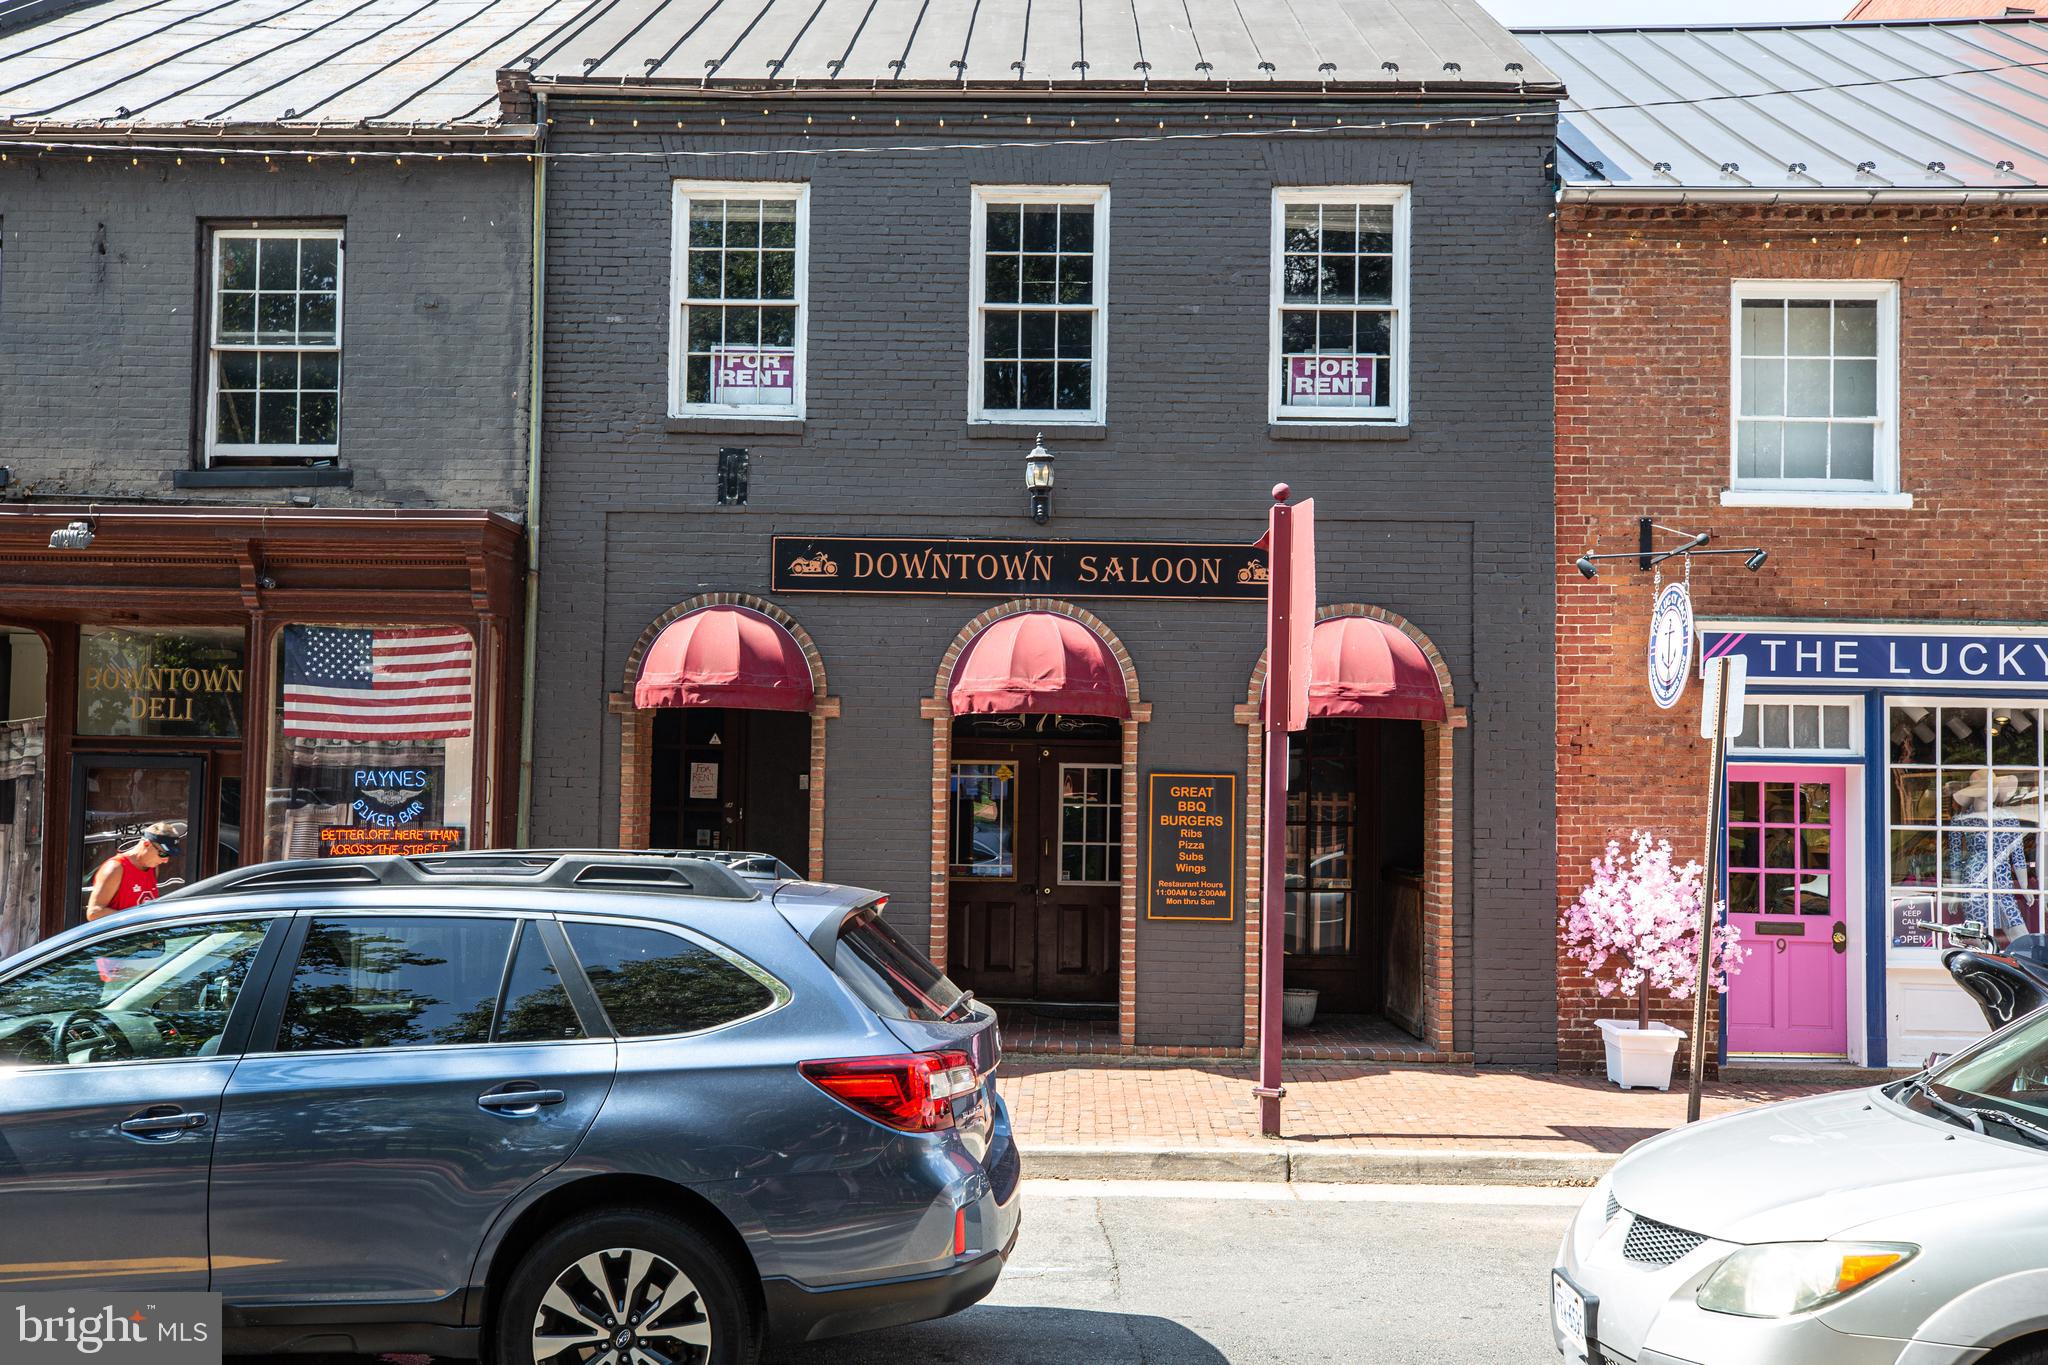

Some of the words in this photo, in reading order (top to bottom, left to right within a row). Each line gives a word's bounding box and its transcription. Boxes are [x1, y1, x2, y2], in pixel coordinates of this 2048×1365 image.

[727, 353, 781, 369] FOR
[1304, 359, 1360, 376] FOR
[718, 369, 790, 386] RENT
[1295, 377, 1369, 393] RENT
[853, 547, 1054, 583] DOWNTOWN
[1078, 555, 1222, 585] SALOON
[1760, 639, 1859, 673] THE
[85, 664, 245, 693] DOWNTOWN
[130, 696, 194, 722] DELI
[354, 770, 427, 787] PAYNES
[1170, 786, 1214, 798] GREAT
[1177, 801, 1207, 812] BBQ
[352, 799, 395, 827] BIKER
[398, 800, 425, 824] BAR
[1160, 815, 1224, 827] BURGERS
[115, 823, 148, 835] NEX
[321, 829, 364, 841] BETTER
[368, 829, 391, 841] OFF
[395, 830, 424, 841] HERE
[1180, 829, 1203, 838] Ribs
[330, 844, 373, 856] ACROSS
[375, 844, 400, 855] THE
[1178, 840, 1205, 850] Pizza
[1178, 852, 1204, 861] Subs
[1176, 863, 1207, 874] Wings
[1158, 880, 1200, 888] Restaurant
[1200, 880, 1223, 888] Hours
[1166, 897, 1182, 905] Mon
[1183, 897, 1199, 905] thru
[1899, 935, 1926, 944] OPEN
[1776, 938, 1787, 954] 9
